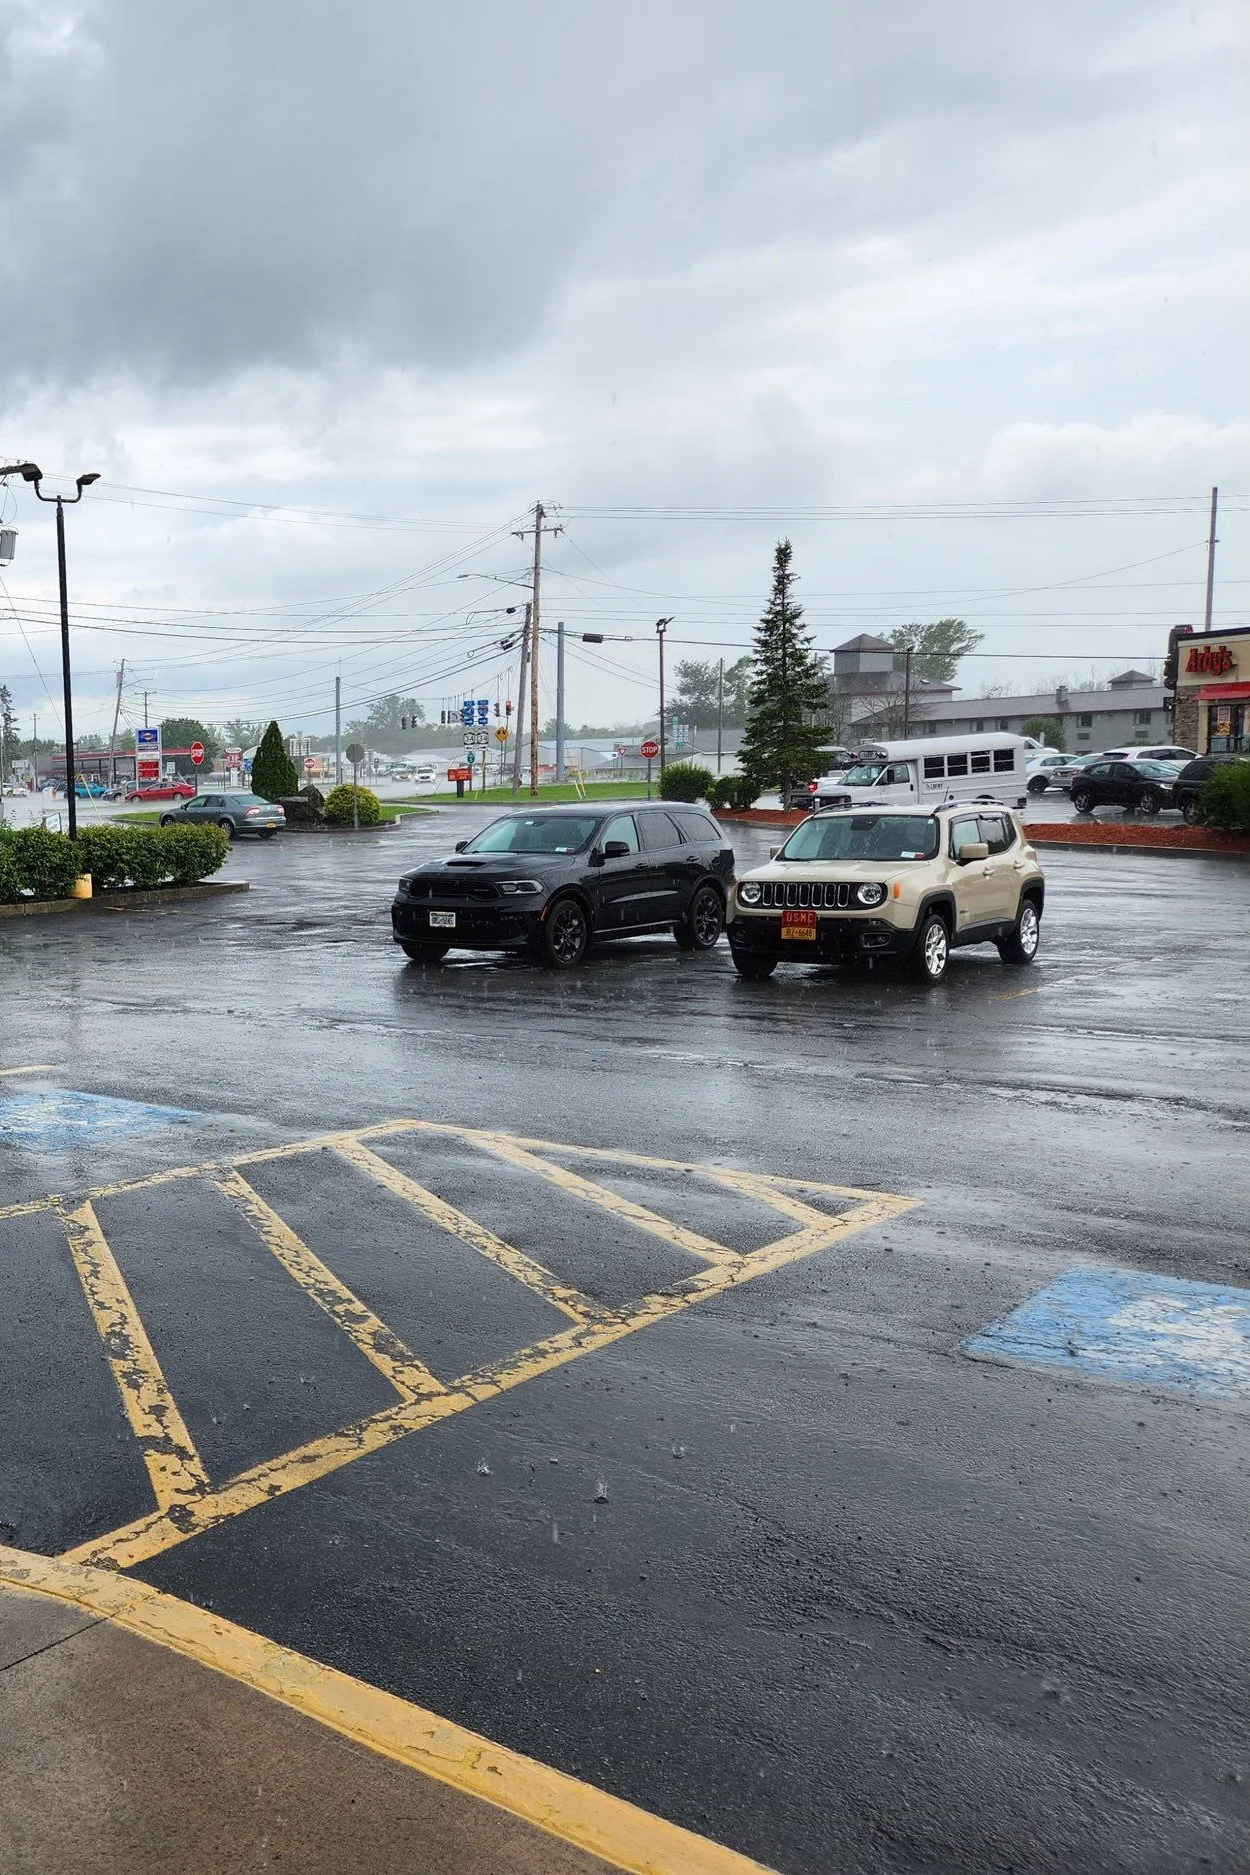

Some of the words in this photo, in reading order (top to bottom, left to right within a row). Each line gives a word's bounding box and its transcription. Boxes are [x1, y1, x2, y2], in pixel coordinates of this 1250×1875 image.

[1185, 645, 1235, 676] Arby's
[191, 749, 204, 758] STOP
[642, 746, 658, 754] STOP
[786, 912, 814, 922] USMC
